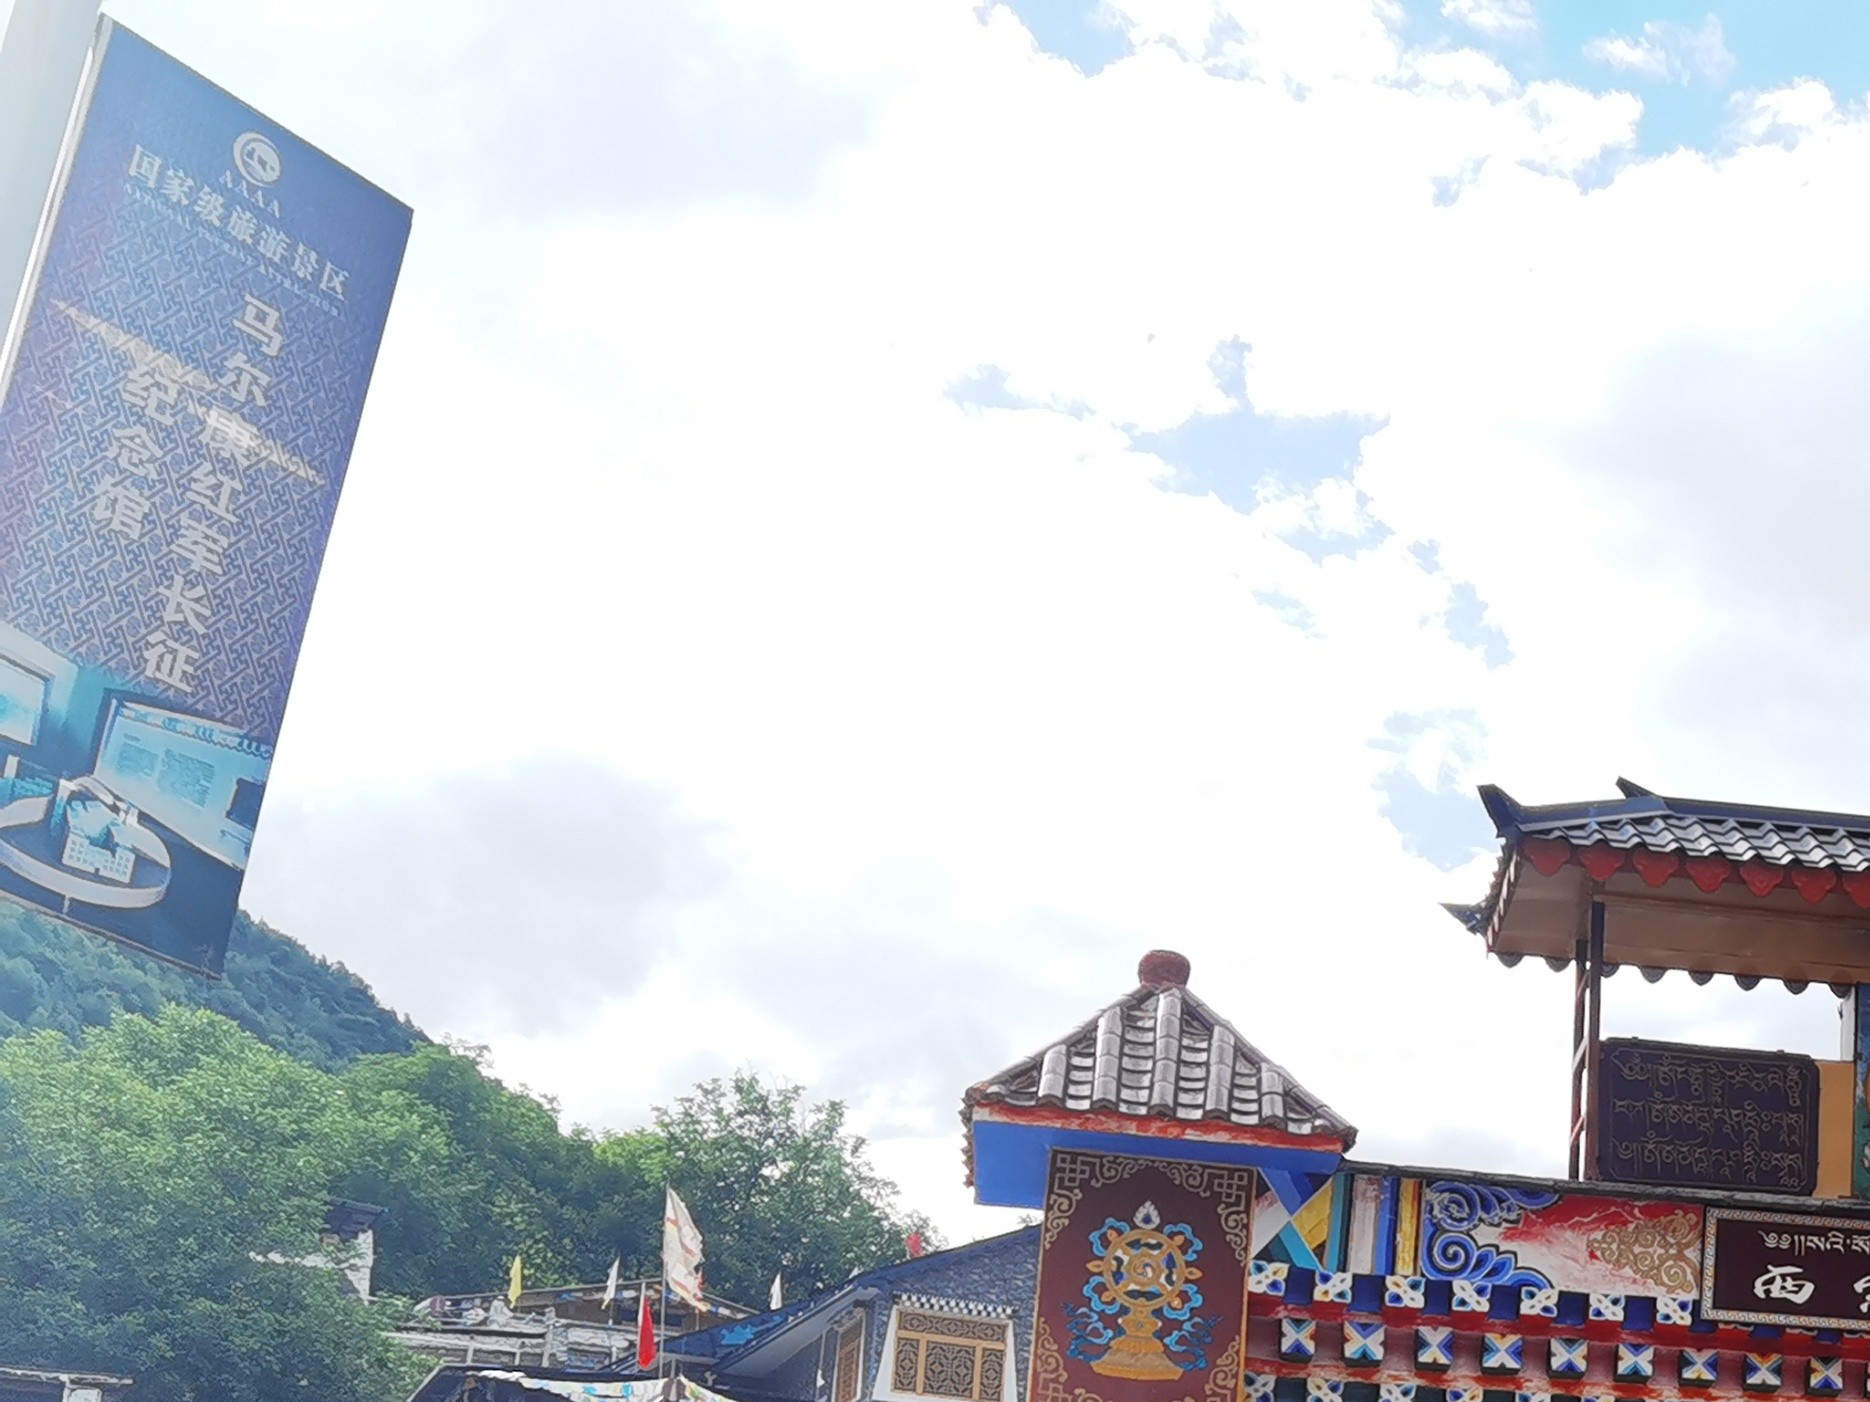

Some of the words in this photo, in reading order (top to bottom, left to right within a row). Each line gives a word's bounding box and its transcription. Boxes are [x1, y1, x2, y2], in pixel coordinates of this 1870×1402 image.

[126, 143, 350, 302] 国家级旅游景区
[88, 361, 185, 541] 纪念馆
[141, 293, 283, 693] 马尔康红军长征
